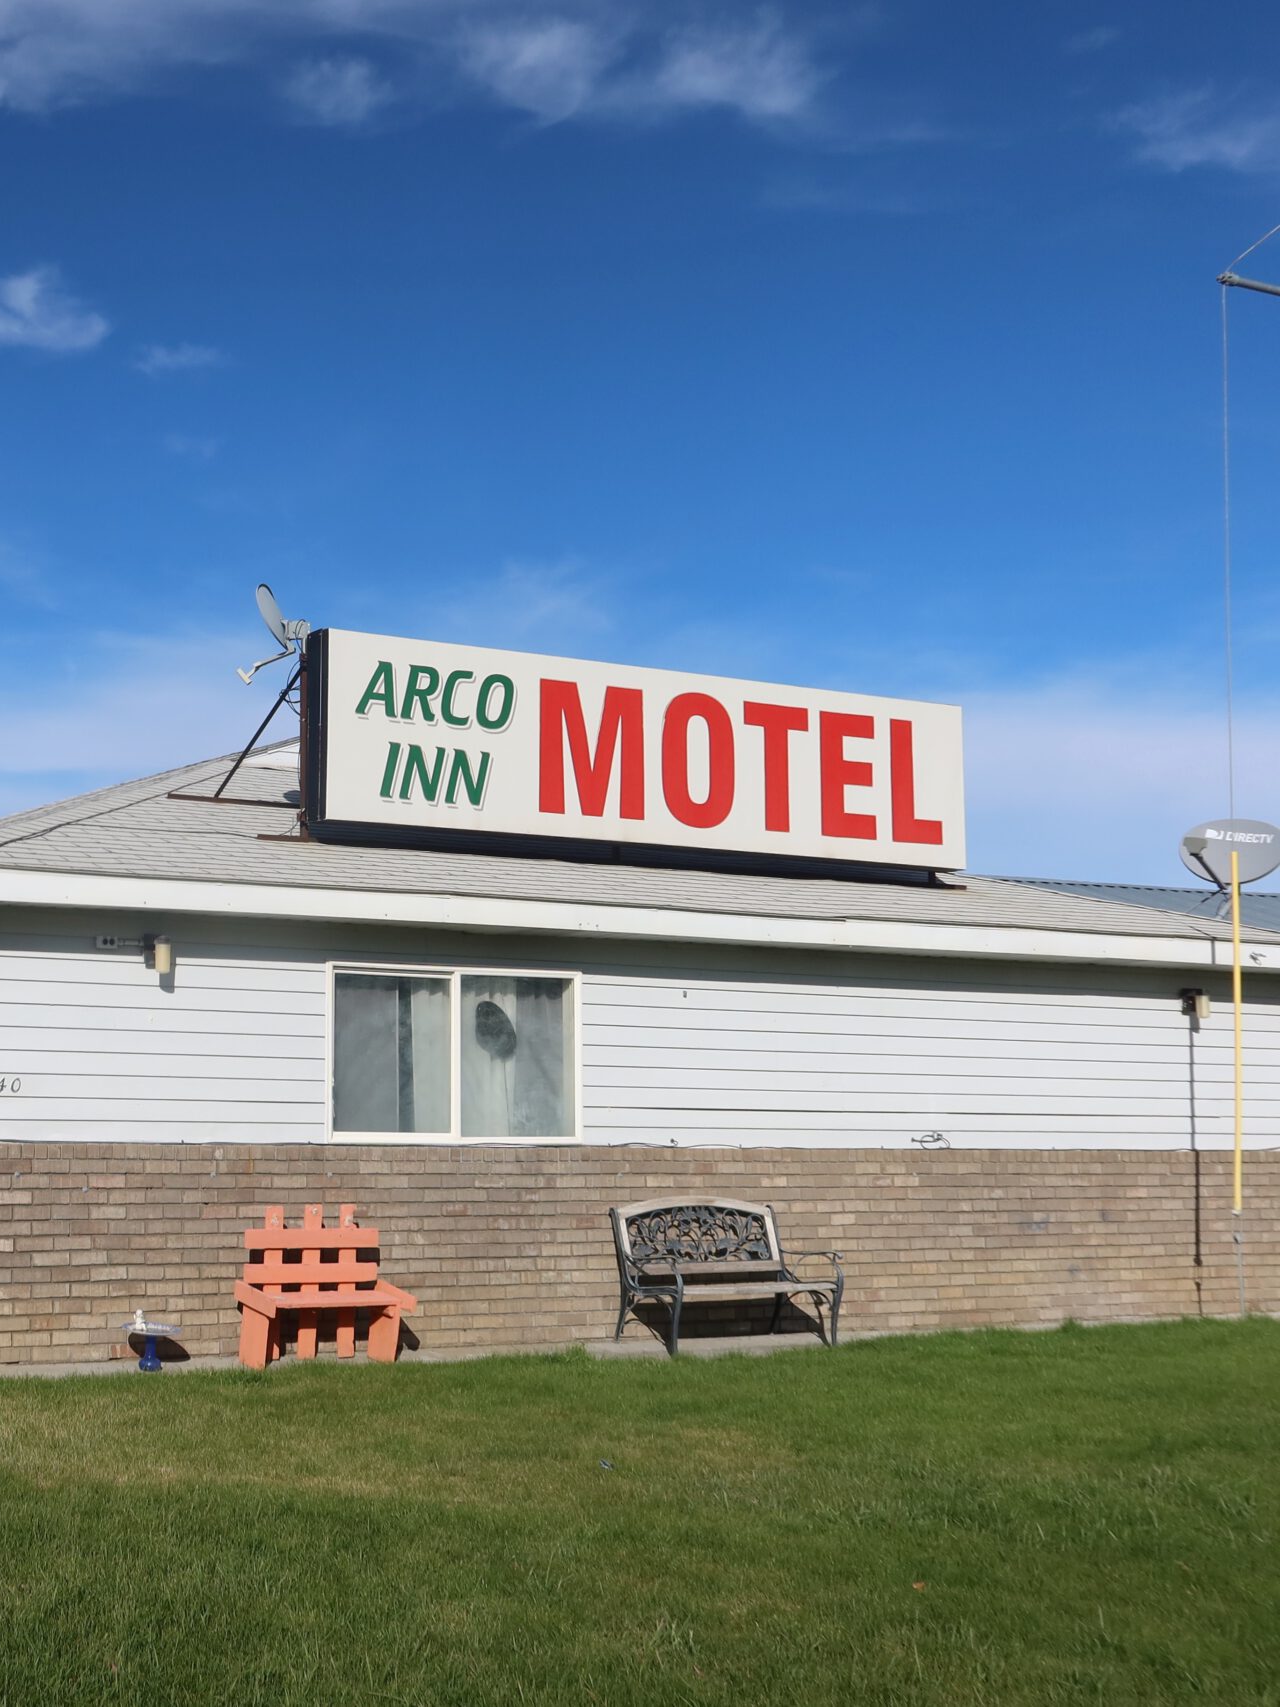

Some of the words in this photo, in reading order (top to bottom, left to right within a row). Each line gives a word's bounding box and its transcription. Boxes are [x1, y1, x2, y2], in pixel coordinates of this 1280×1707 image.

[355, 660, 515, 731] ARCO
[380, 741, 490, 807] INN
[539, 678, 943, 846] MOTEL
[1225, 831, 1274, 843] DIRECTV
